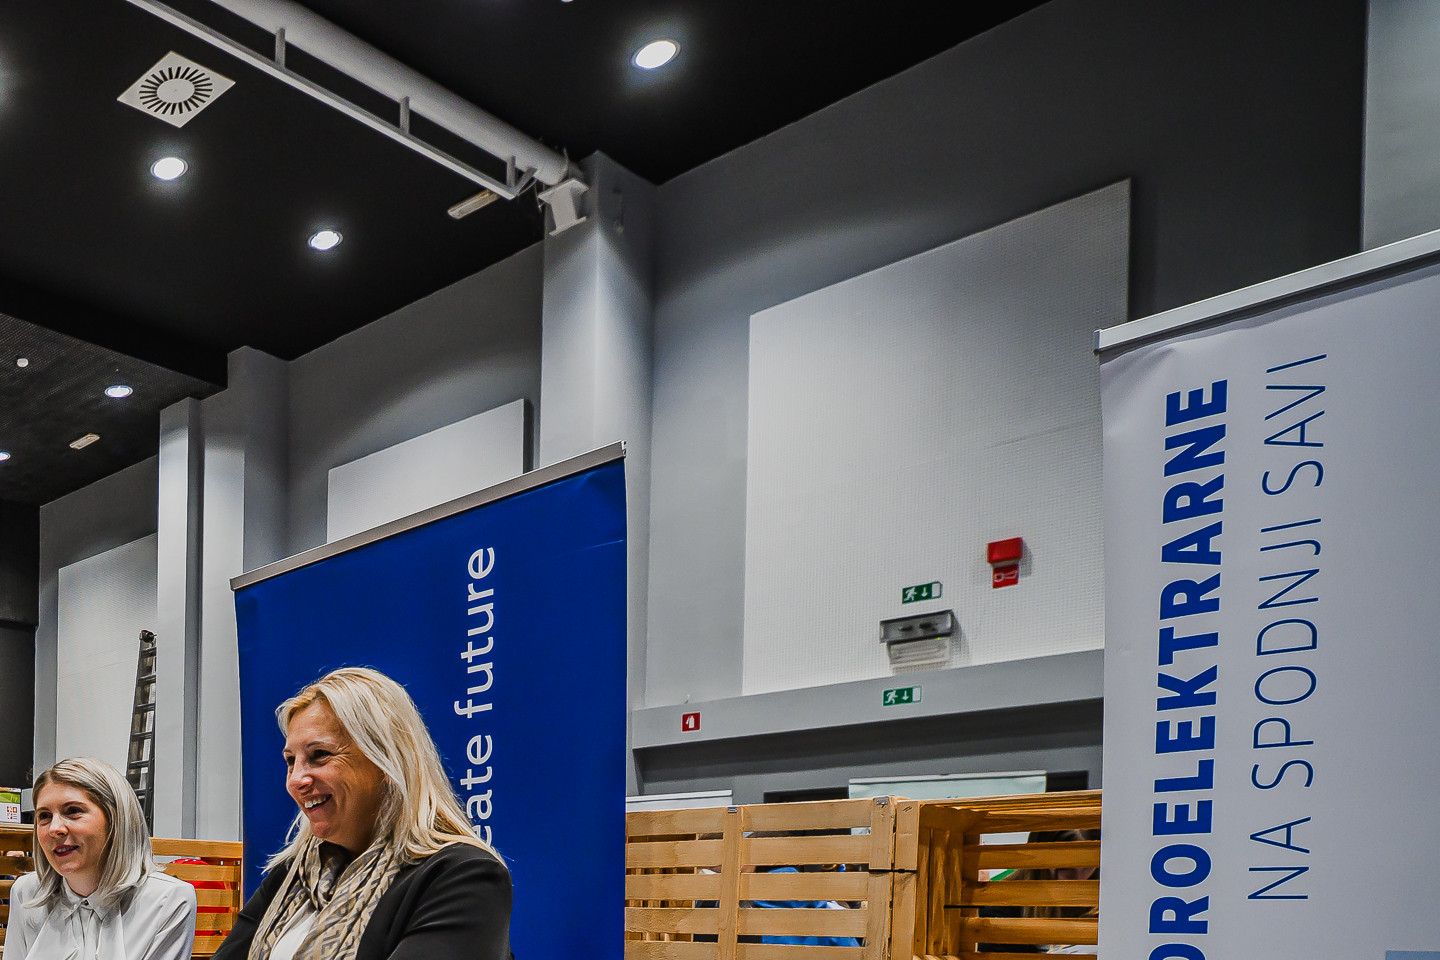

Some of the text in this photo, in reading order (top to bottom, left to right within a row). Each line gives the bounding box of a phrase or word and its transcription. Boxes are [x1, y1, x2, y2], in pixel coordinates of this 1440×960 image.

[454, 546, 495, 719] future
[1247, 354, 1328, 902] NA SPODNJI SAVI
